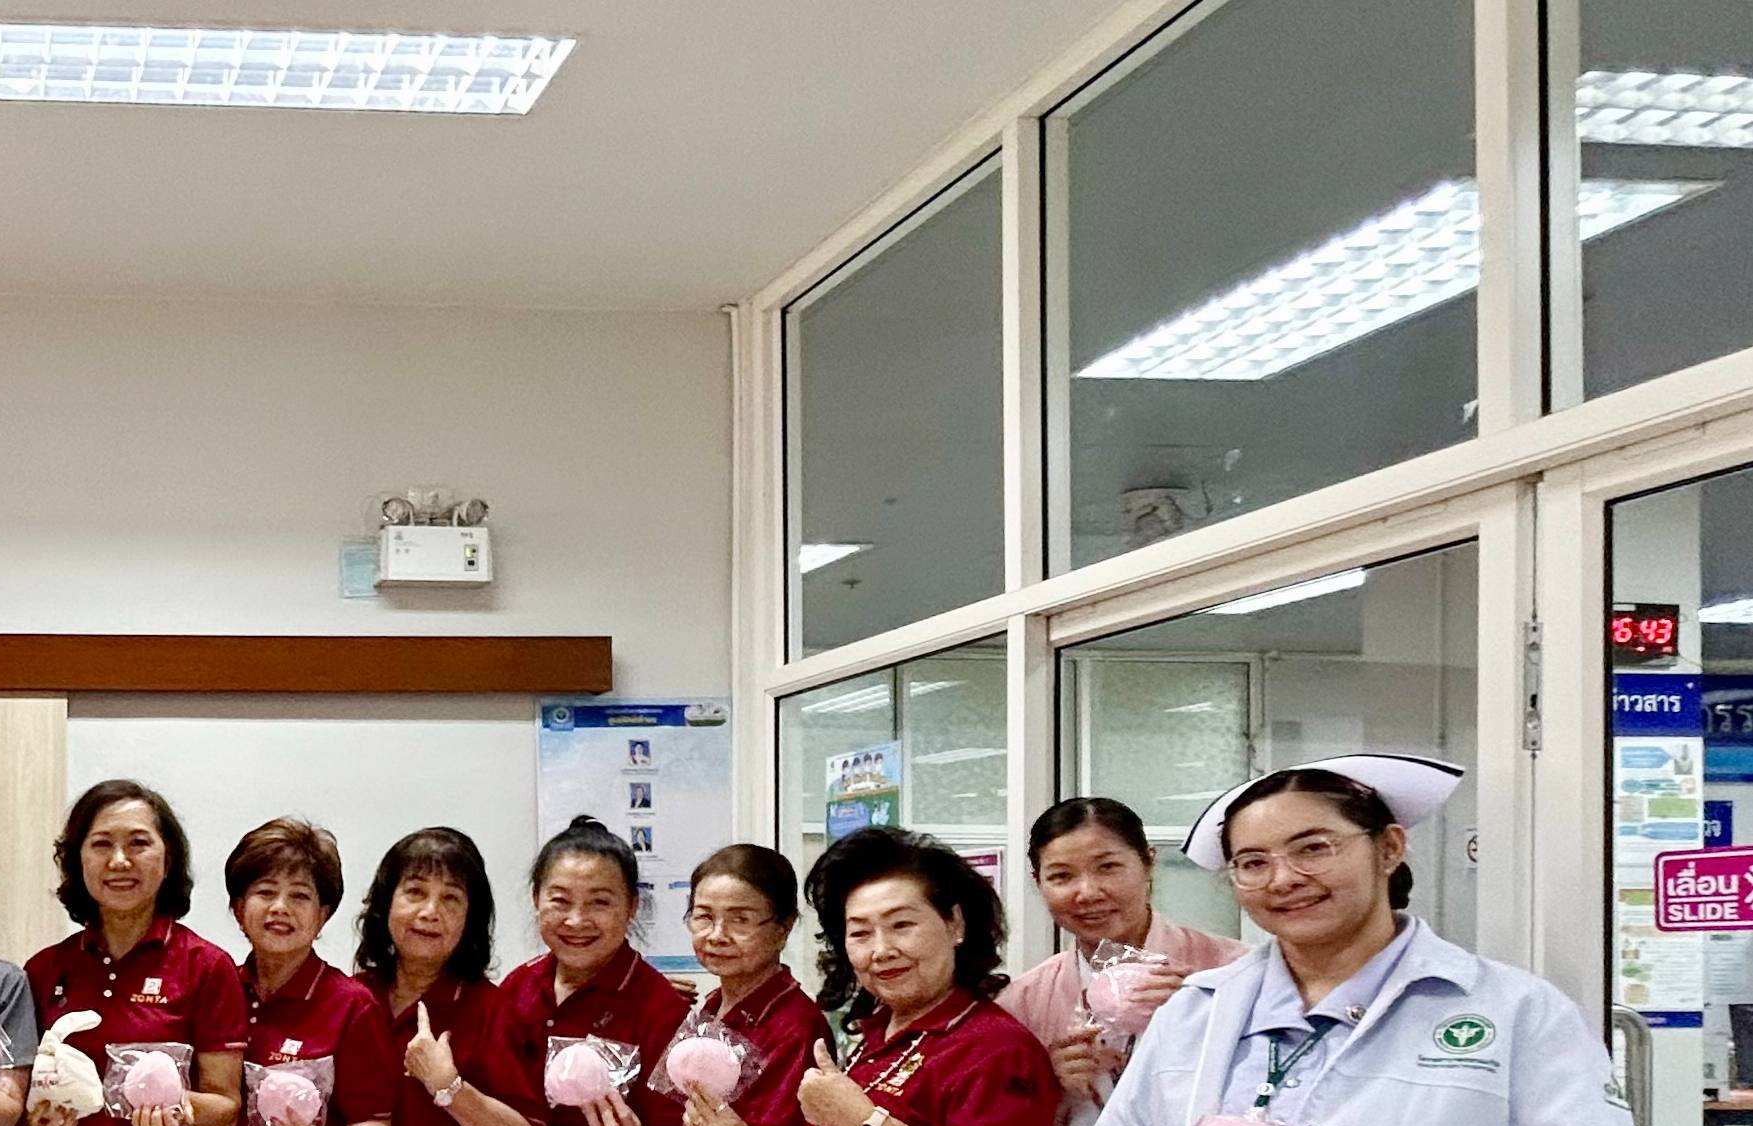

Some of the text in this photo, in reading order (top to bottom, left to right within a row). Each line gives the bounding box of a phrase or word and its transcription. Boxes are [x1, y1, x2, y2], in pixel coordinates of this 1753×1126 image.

[1666, 861, 1740, 897] เลื่อน
[1667, 902, 1740, 922] SLIDE
